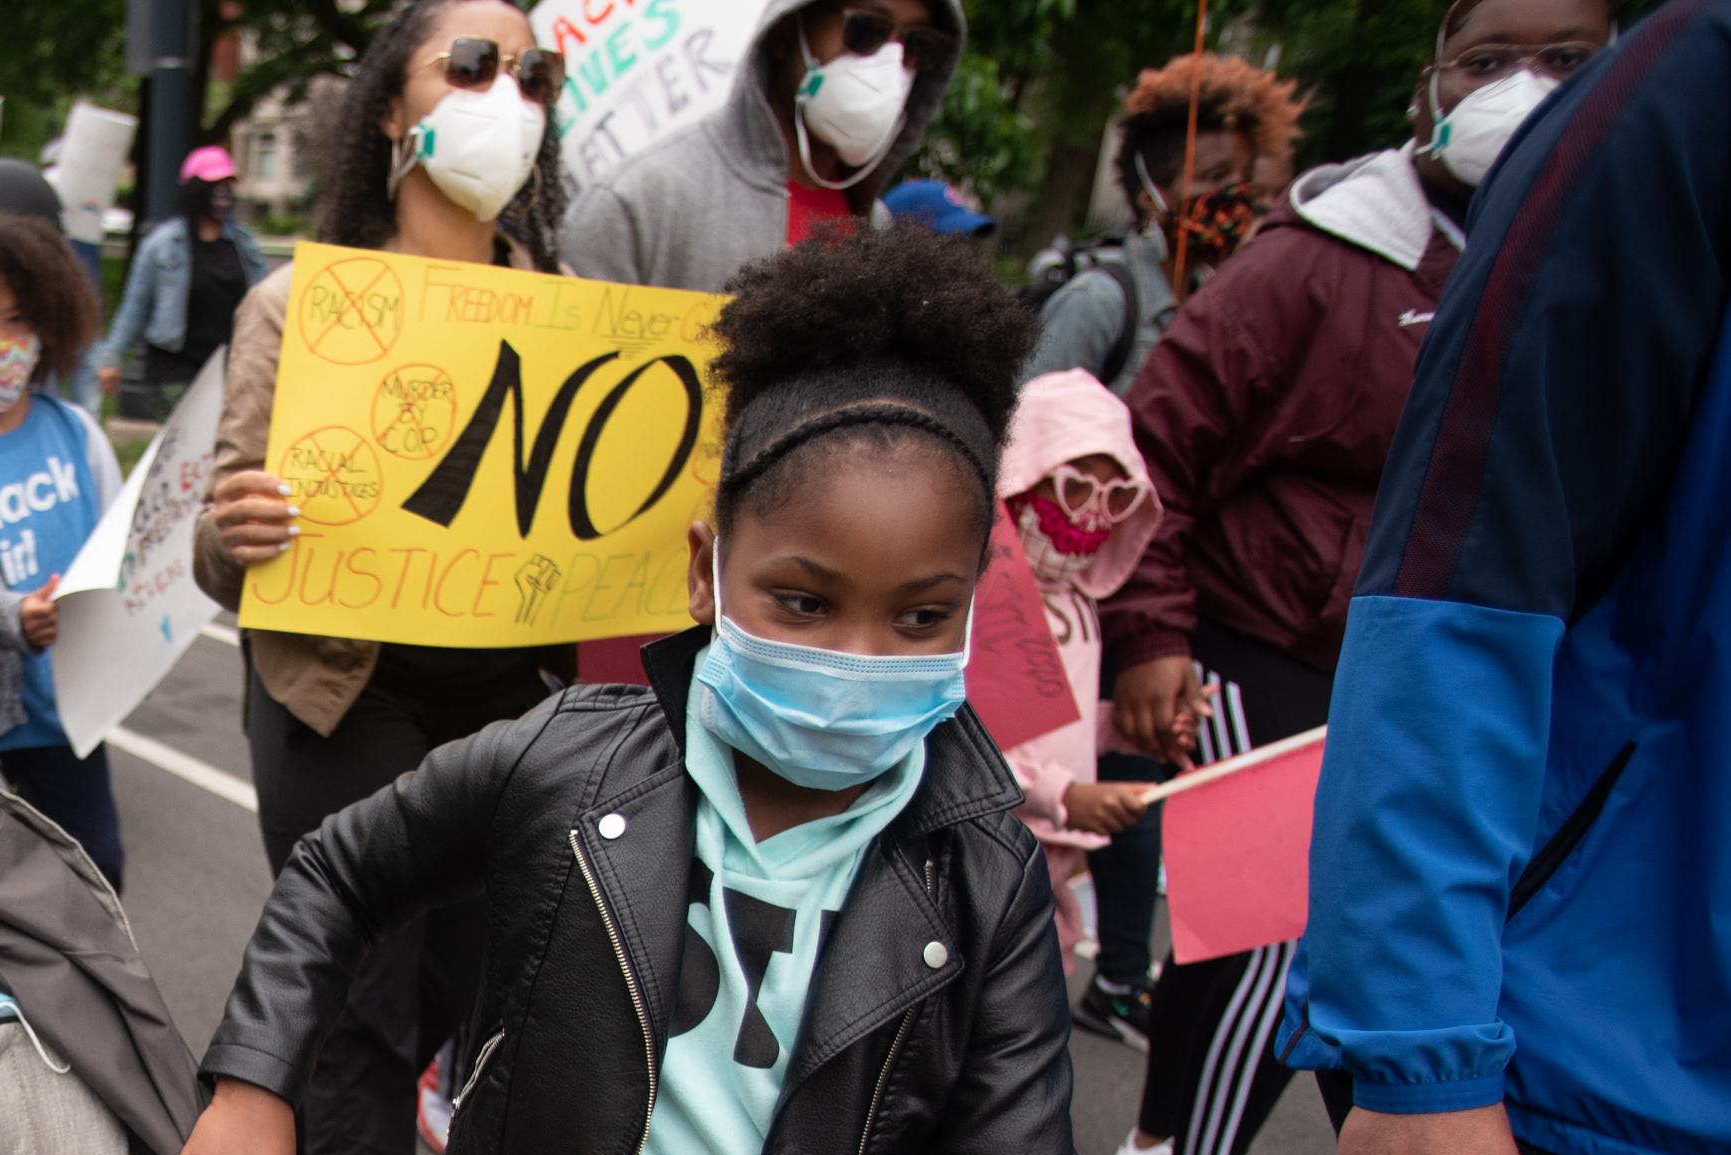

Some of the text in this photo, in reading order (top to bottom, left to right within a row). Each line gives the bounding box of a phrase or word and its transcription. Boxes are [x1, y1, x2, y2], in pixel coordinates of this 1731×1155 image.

[558, 27, 737, 195] ATTER
[310, 285, 400, 331] RACISM
[418, 264, 534, 326] FREEDOM
[592, 284, 680, 336] Never
[383, 427, 439, 454] COP
[401, 338, 703, 541] NO
[251, 534, 518, 618] JUSTICE
